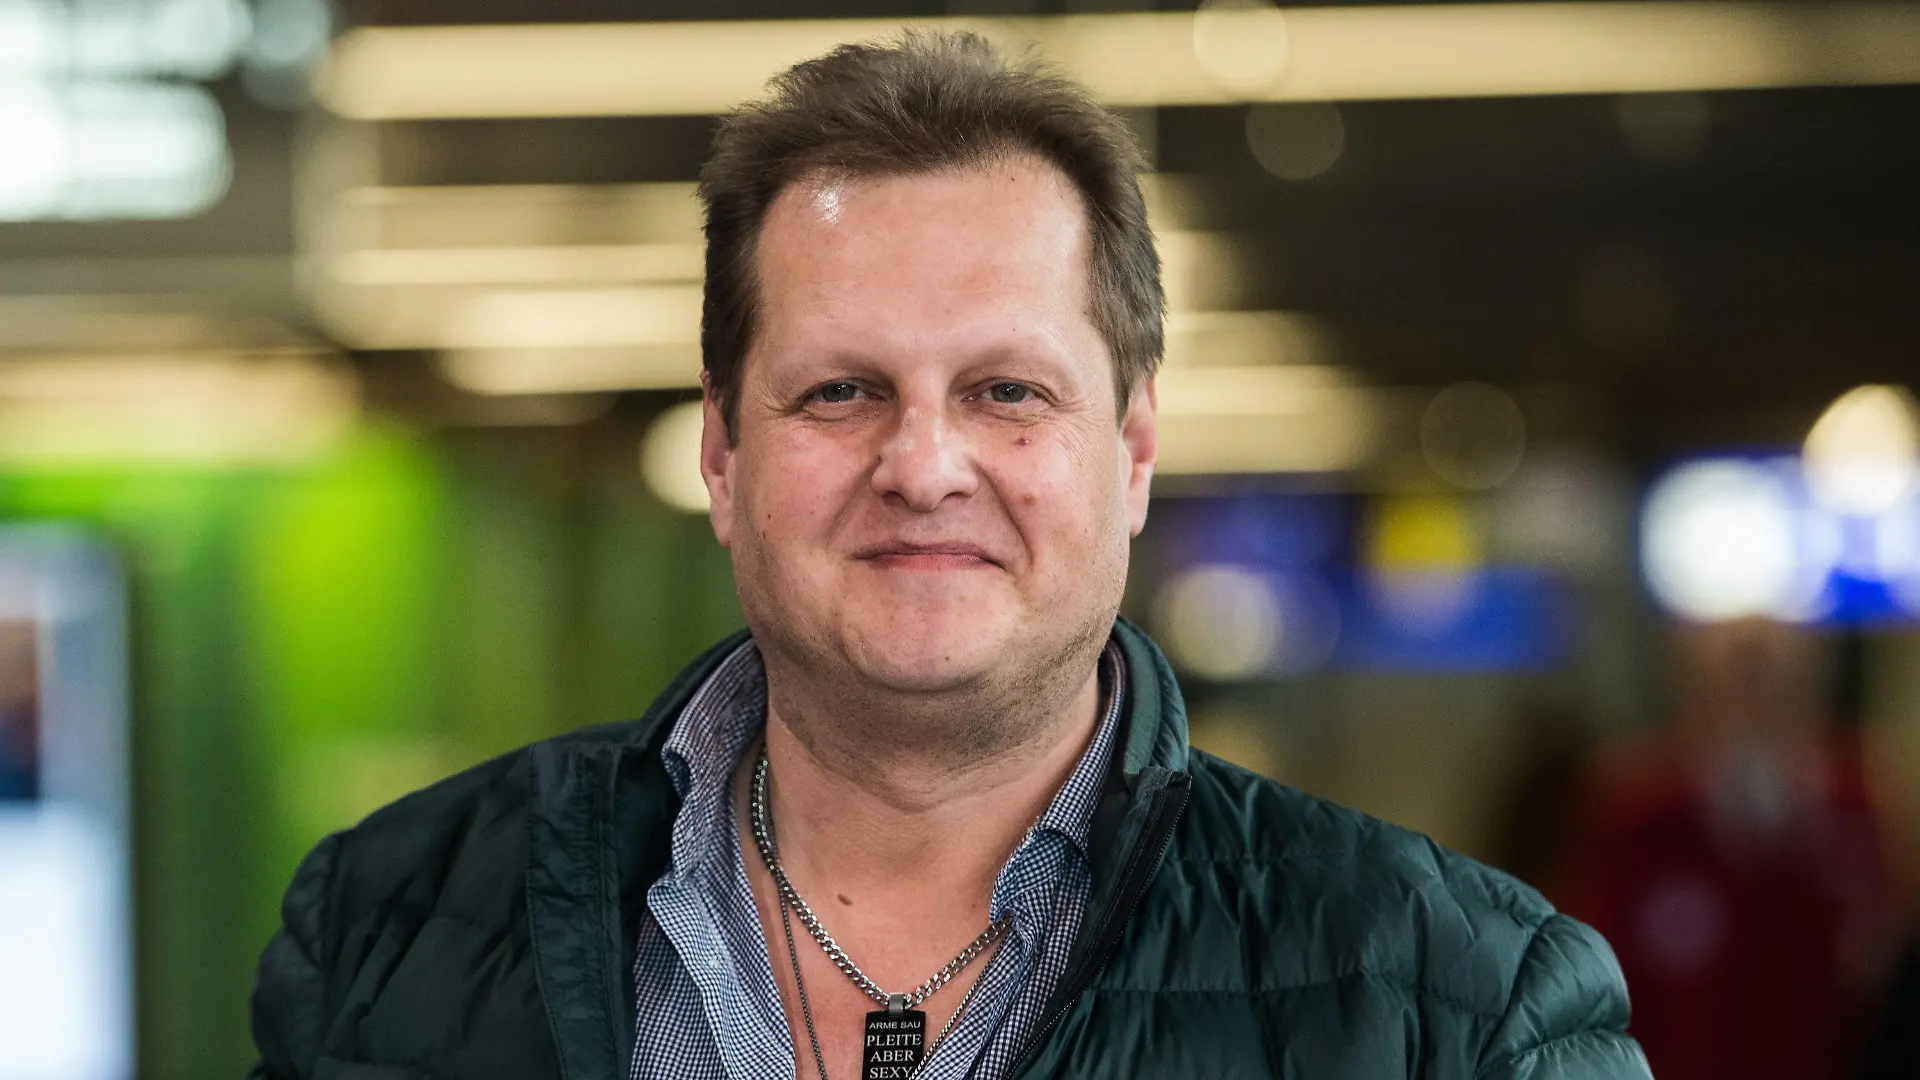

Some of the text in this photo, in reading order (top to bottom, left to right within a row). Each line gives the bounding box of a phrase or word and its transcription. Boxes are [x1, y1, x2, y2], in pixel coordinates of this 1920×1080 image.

[869, 1021, 921, 1030] ARME SAU
[866, 1033, 922, 1047] PLEITE
[870, 1050, 914, 1062] ABER
[869, 1066, 913, 1079] SEXY
